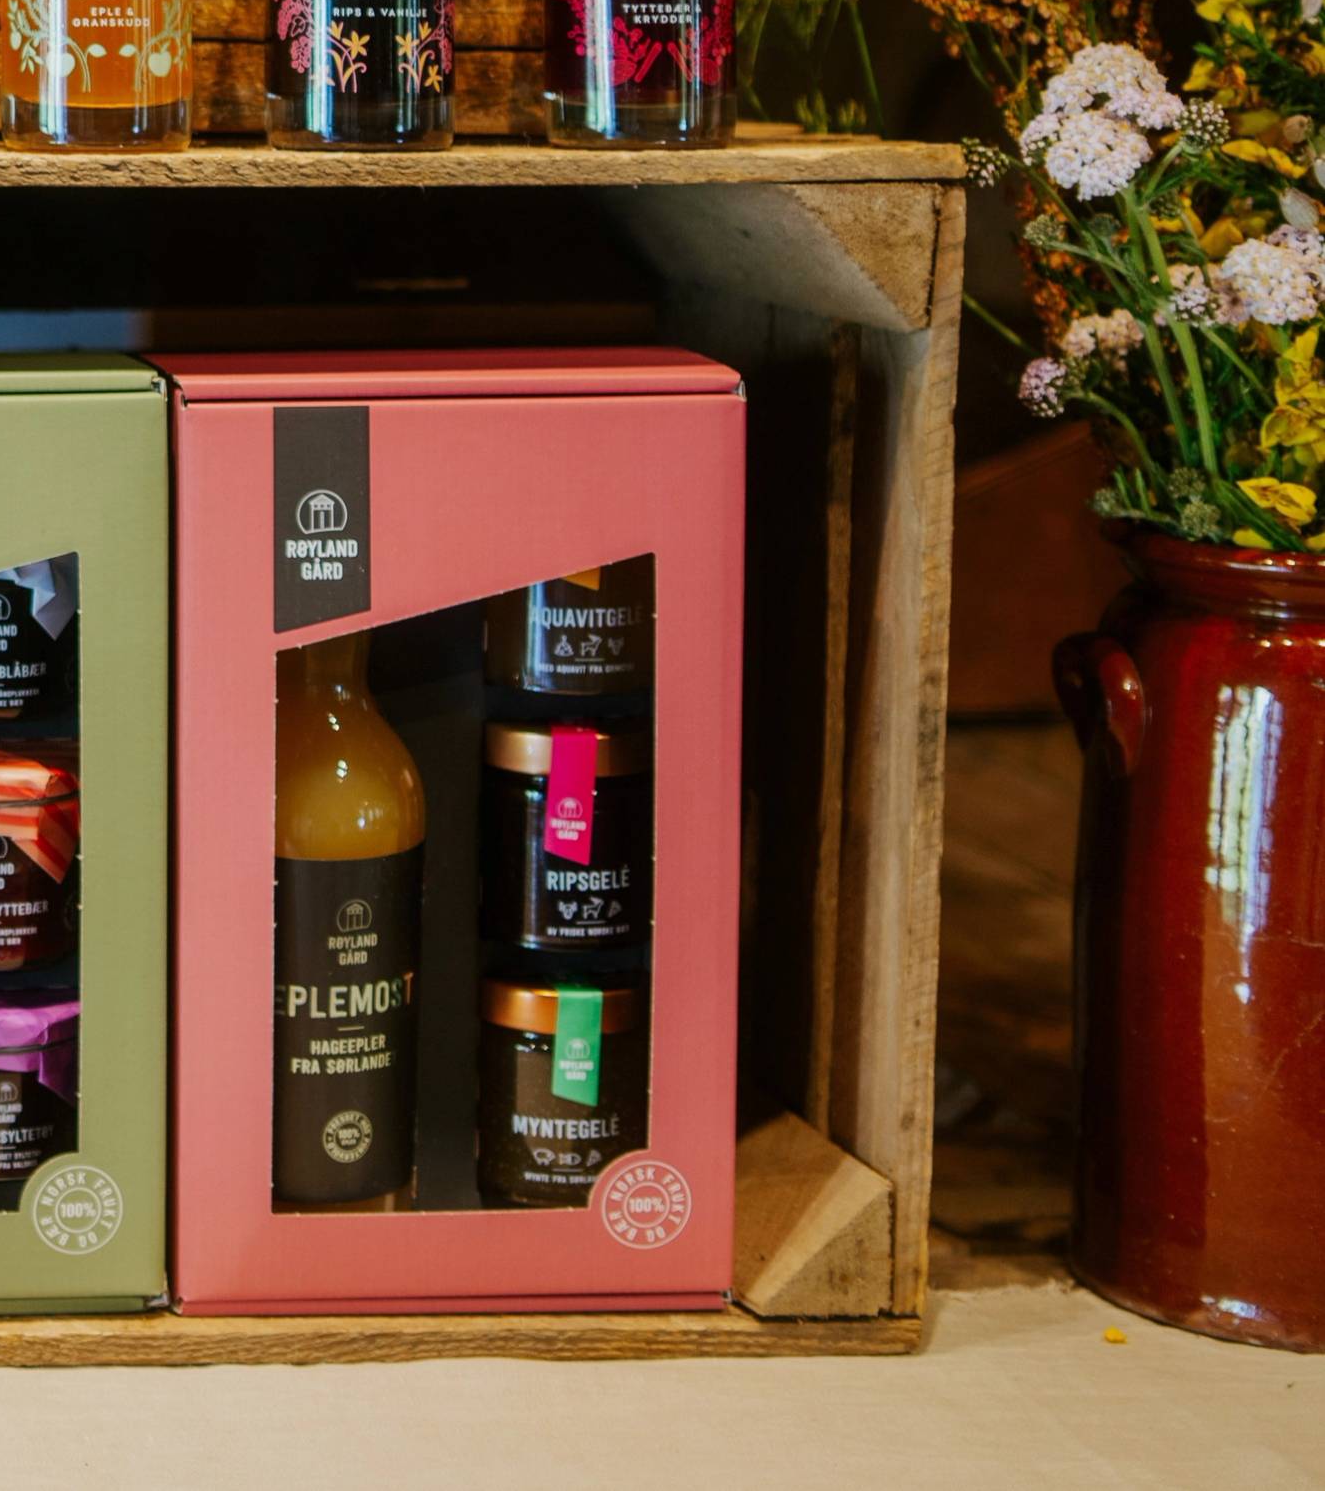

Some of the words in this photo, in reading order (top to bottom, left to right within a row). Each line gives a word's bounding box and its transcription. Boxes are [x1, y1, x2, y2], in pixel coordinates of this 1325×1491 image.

[91, 7, 122, 17] EPLE
[333, 8, 362, 17] RIPS
[380, 8, 427, 17] VANILJE
[623, 4, 690, 14] TYTTEBÆR
[72, 18, 151, 28] GRANSKUDD
[634, 15, 693, 24] KRYDDER
[286, 540, 358, 558] RØYLAND
[301, 558, 343, 581] GÅRD
[547, 865, 630, 892] RIPSGELÉ
[311, 1034, 386, 1055] HAGEEPLER
[512, 1113, 620, 1140] MYNTEGELÉ
[41, 1172, 87, 1206] NORSK
[95, 1178, 116, 1230] FRUKT
[630, 1198, 664, 1213] 100%
[61, 1202, 96, 1218] 100%
